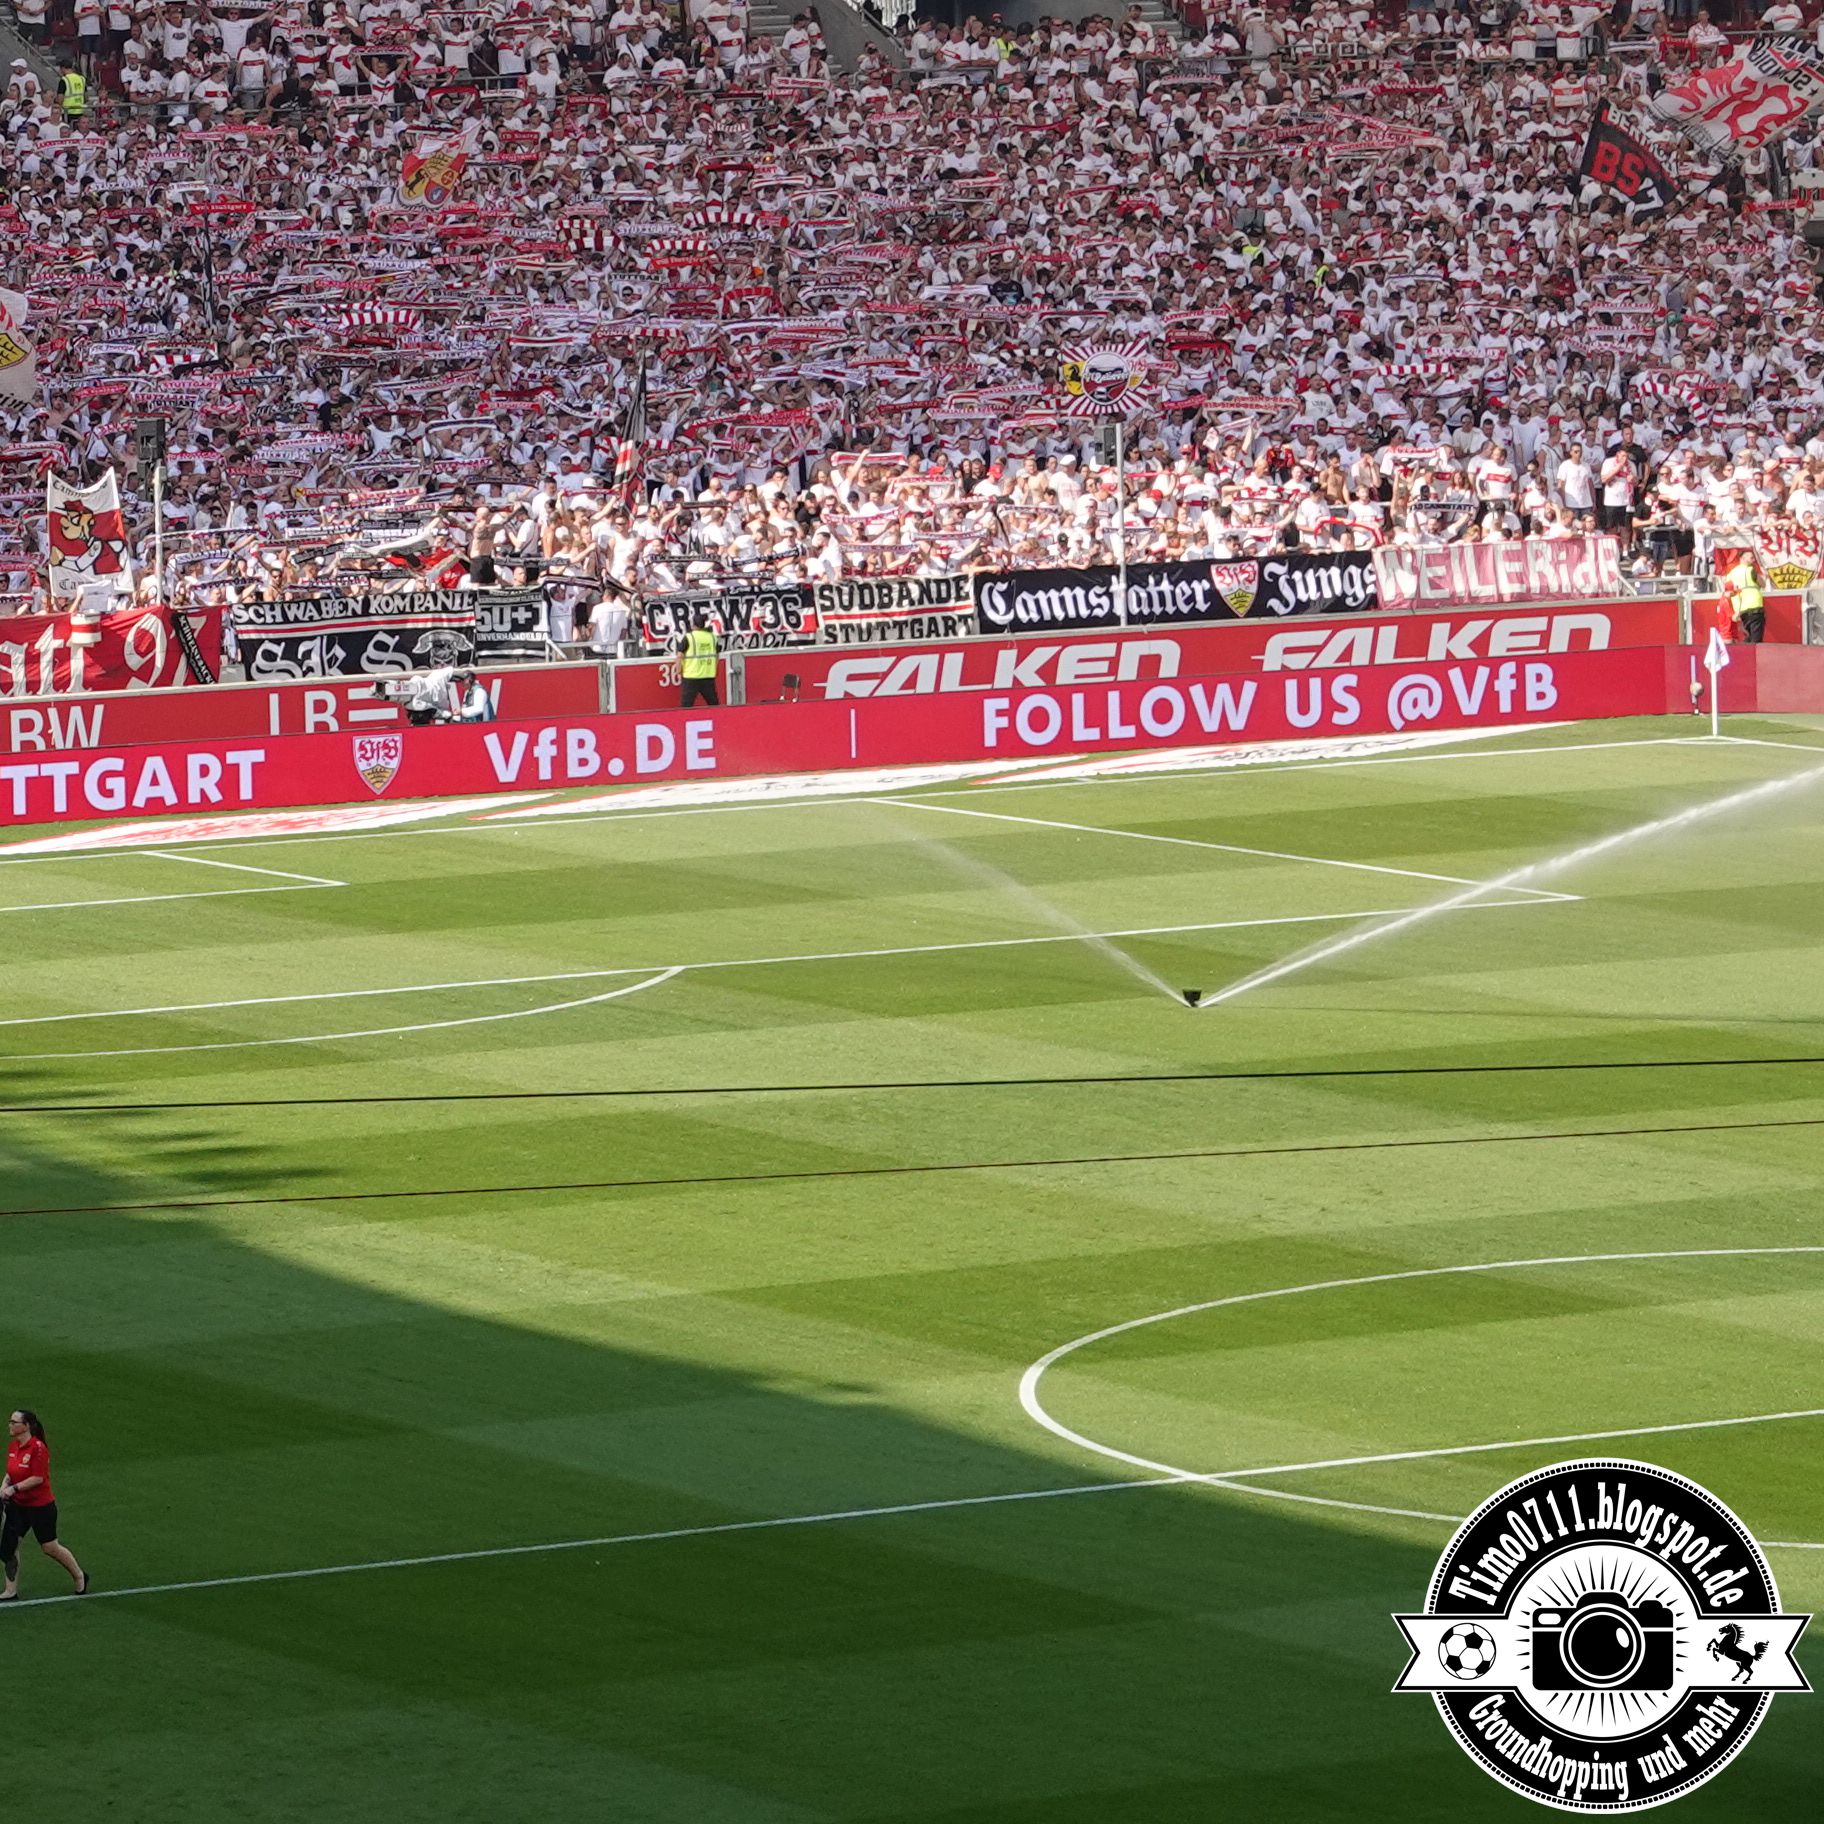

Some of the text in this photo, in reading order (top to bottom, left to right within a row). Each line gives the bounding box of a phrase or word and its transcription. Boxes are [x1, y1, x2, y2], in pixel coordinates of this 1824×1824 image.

[233, 596, 363, 627] SCHWABEN
[367, 589, 475, 616] KOMPANIE
[474, 600, 550, 633] 50+1
[648, 591, 802, 639] CREW 36
[981, 559, 1377, 628] Cannstatter Jungs
[823, 613, 976, 645] STUTTGART
[1251, 612, 1611, 672] FALKEN
[814, 640, 1181, 699] FALKEN
[983, 661, 1559, 748] FOLLOW US @VfB
[483, 719, 717, 786] VfB.DE
